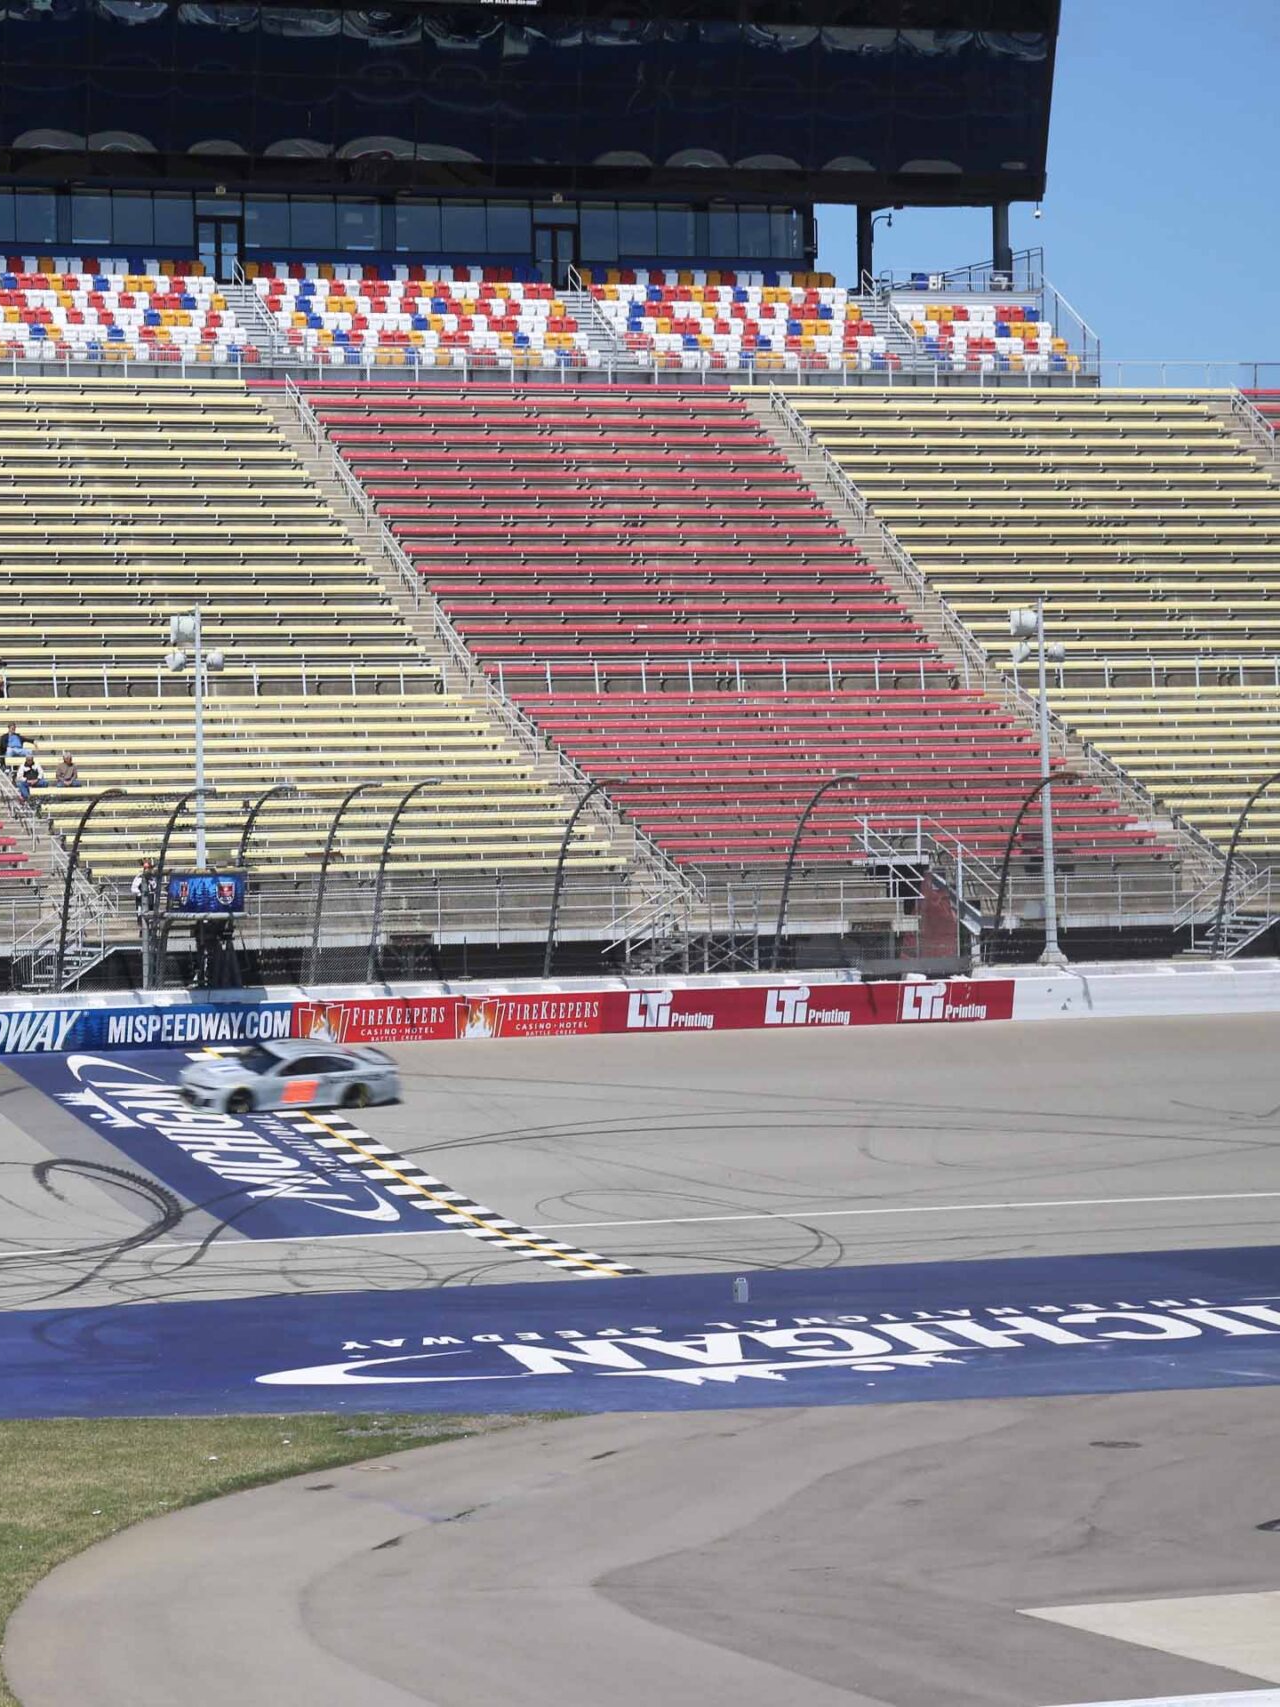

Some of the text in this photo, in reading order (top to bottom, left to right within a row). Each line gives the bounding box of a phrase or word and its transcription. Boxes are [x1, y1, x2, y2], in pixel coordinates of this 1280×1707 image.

[671, 1011, 714, 1029] Printing
[808, 1008, 850, 1025] Printing
[945, 1003, 987, 1020] Printing
[107, 1009, 292, 1044] MISPEEDWAY.COM
[360, 1026, 434, 1036] CASINO HOTEL
[515, 1022, 552, 1031] CASINO
[341, 1298, 1217, 1350] INTERNATIONAL SPEEDWAY
